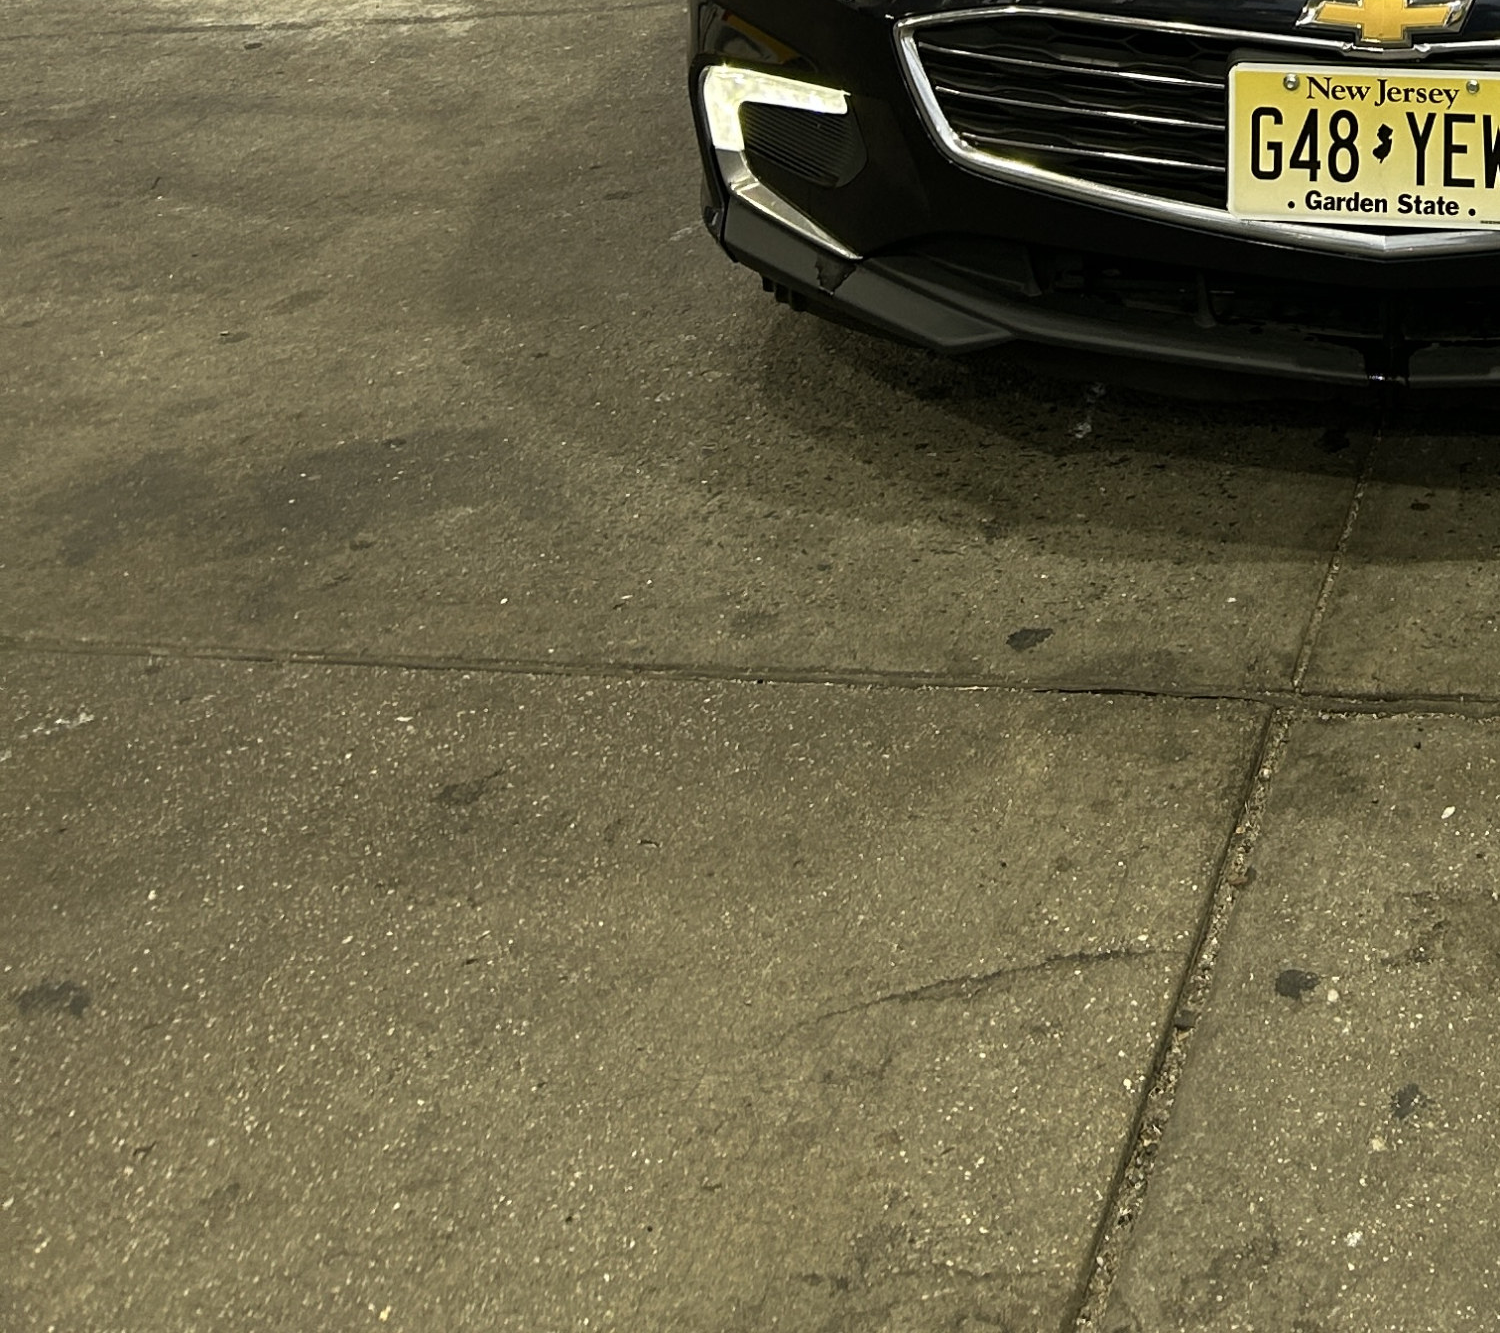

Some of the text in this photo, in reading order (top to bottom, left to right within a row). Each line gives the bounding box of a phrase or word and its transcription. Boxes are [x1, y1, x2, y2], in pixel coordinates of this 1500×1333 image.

[1306, 76, 1460, 109] New Jersey
[1304, 190, 1459, 217] Garden State
